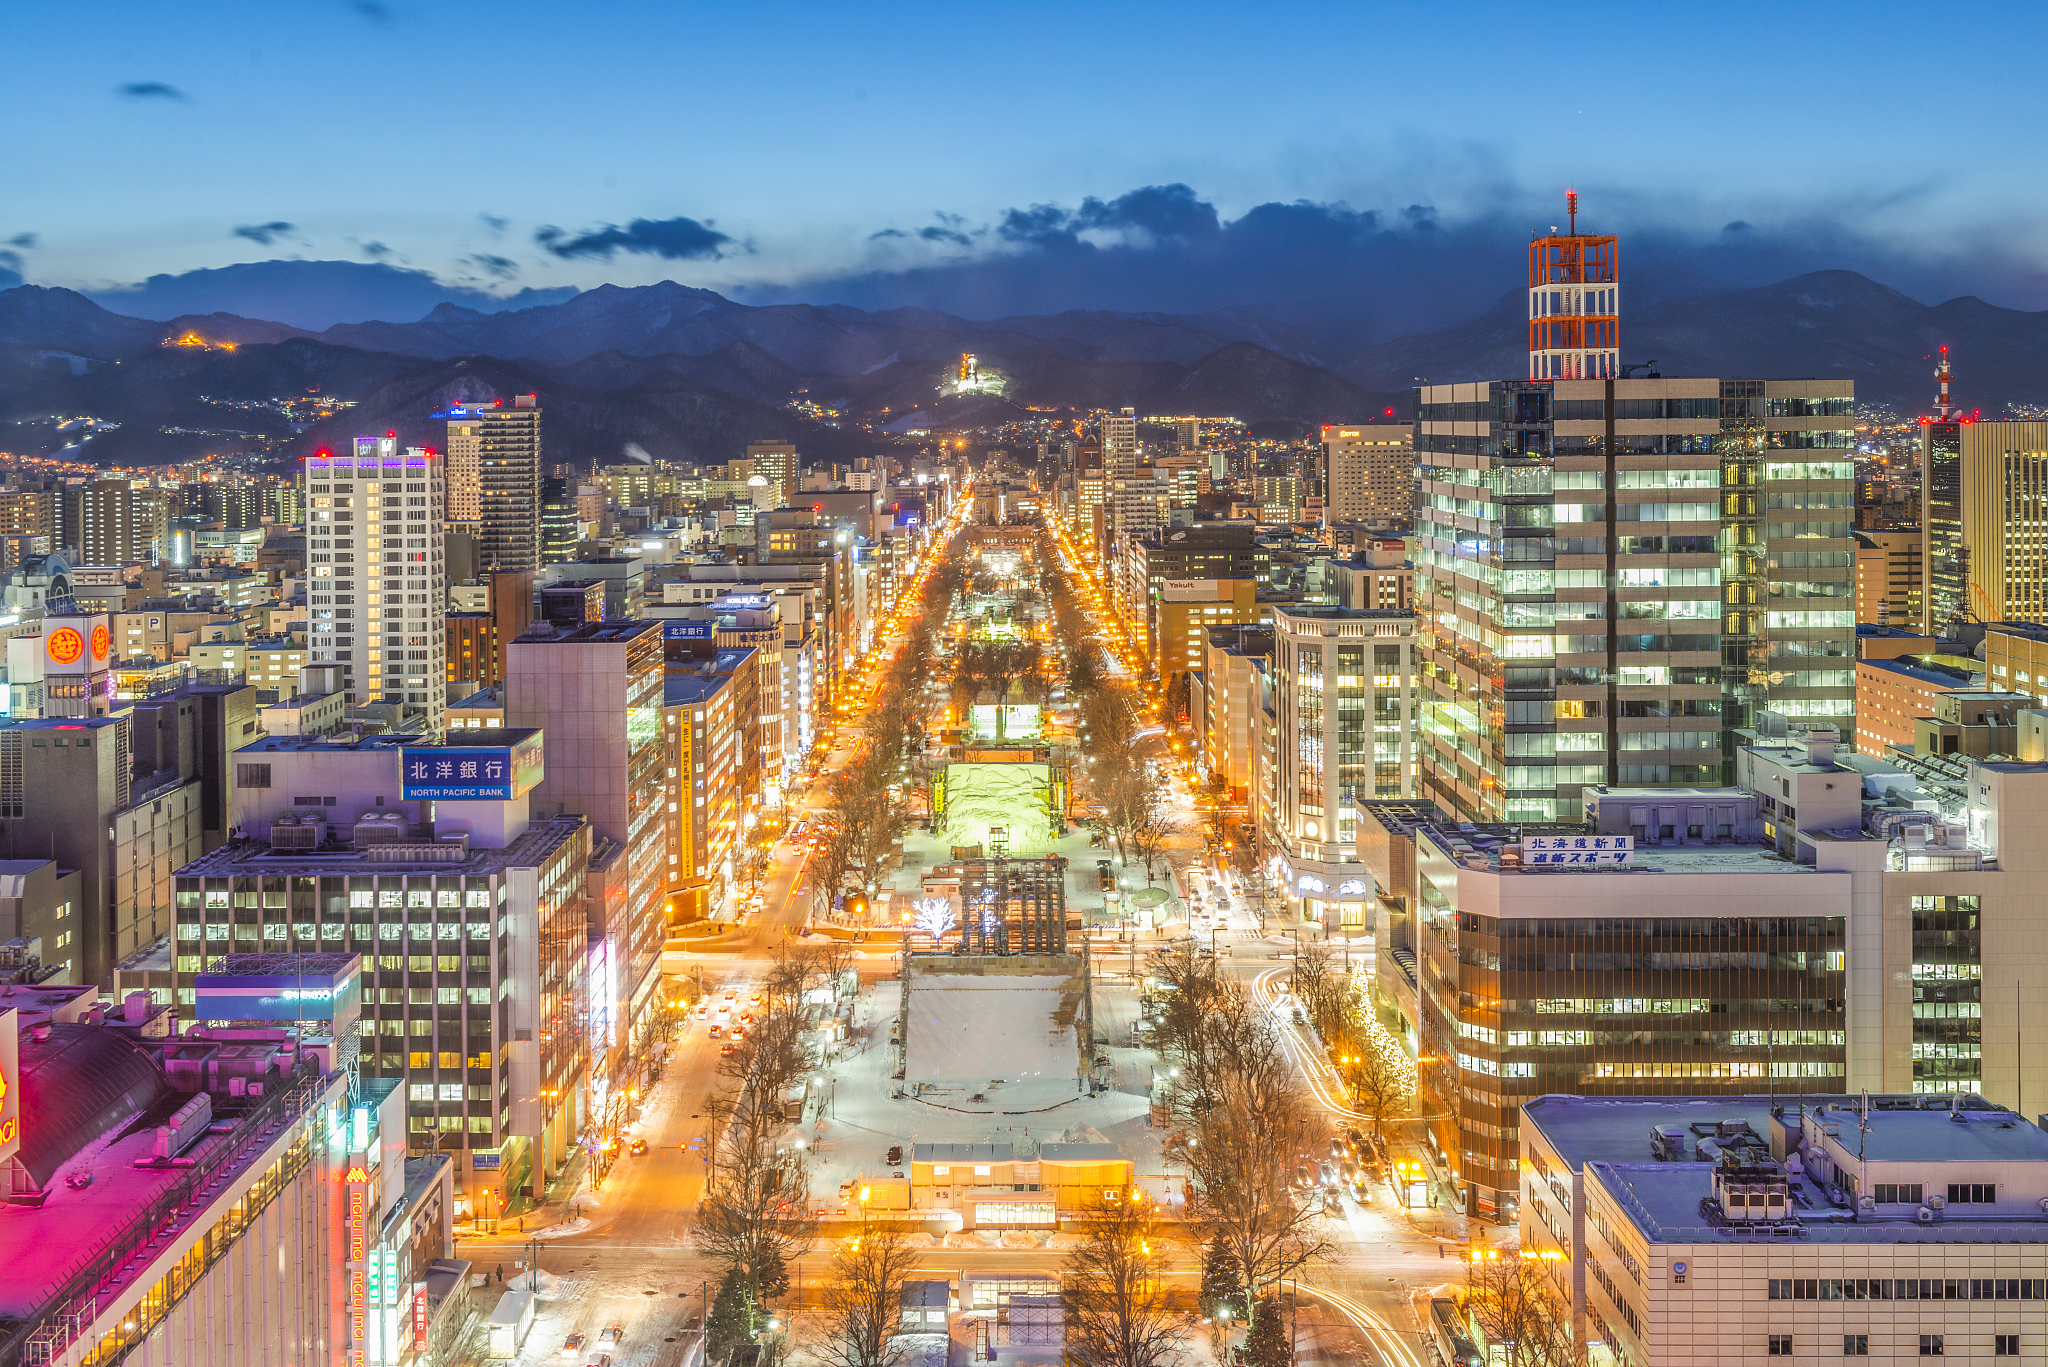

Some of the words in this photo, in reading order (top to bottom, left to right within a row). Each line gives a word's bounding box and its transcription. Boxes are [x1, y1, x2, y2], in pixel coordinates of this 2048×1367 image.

[150, 618, 159, 628] P
[670, 627, 704, 636] 北洋銀行
[410, 760, 503, 779] 北洋銀行
[410, 789, 440, 797] NORTH
[443, 788, 476, 796] PACIFIC
[479, 788, 504, 796] BANK
[1531, 837, 1627, 849] 北海道新聞
[1532, 851, 1627, 863] 道新スポーツ
[352, 1192, 364, 1231] marui
[352, 1234, 364, 1263] imai
[353, 1271, 364, 1310] marui
[416, 1296, 425, 1331] 北陸銀行
[353, 1313, 365, 1341] imai
